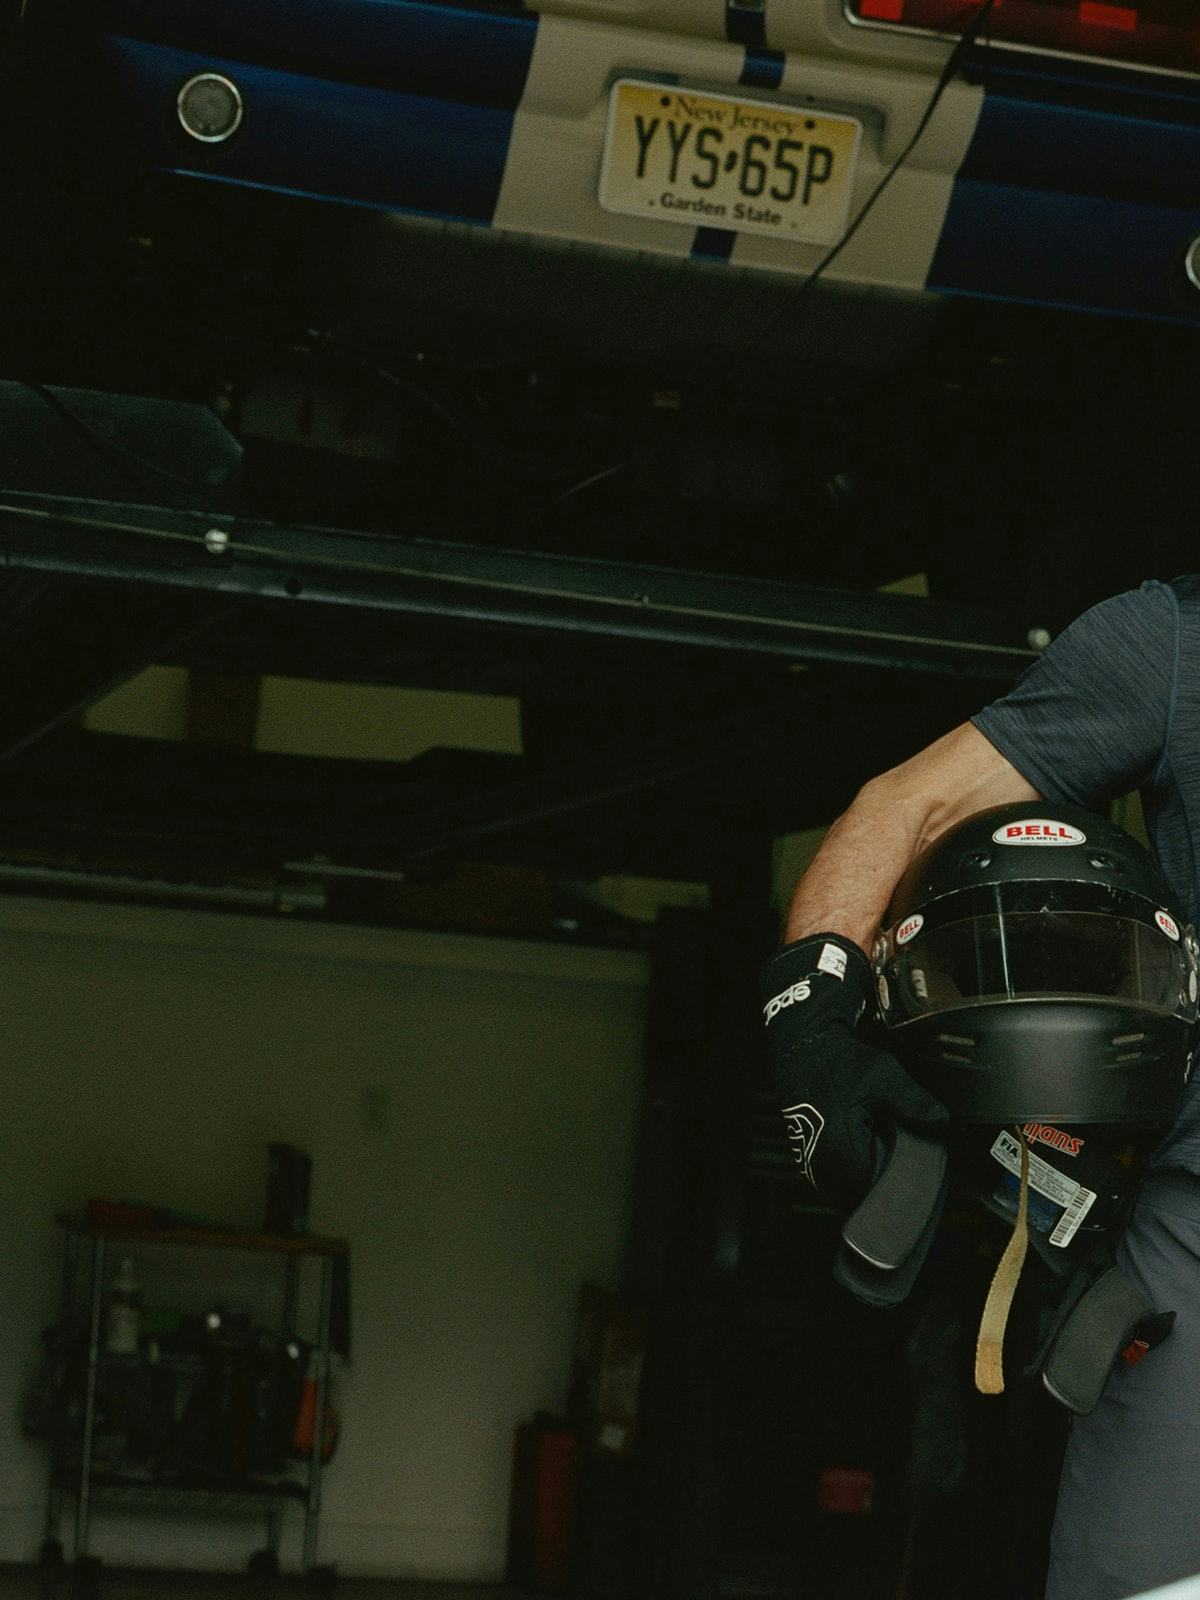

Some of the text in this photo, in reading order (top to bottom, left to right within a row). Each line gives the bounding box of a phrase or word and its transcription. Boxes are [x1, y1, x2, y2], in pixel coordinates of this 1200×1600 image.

[675, 97, 799, 134] New Jersey
[661, 192, 781, 225] Garden State
[1007, 826, 1073, 839] BELL
[900, 920, 920, 937] BELL
[1000, 1138, 1018, 1157] FIA
